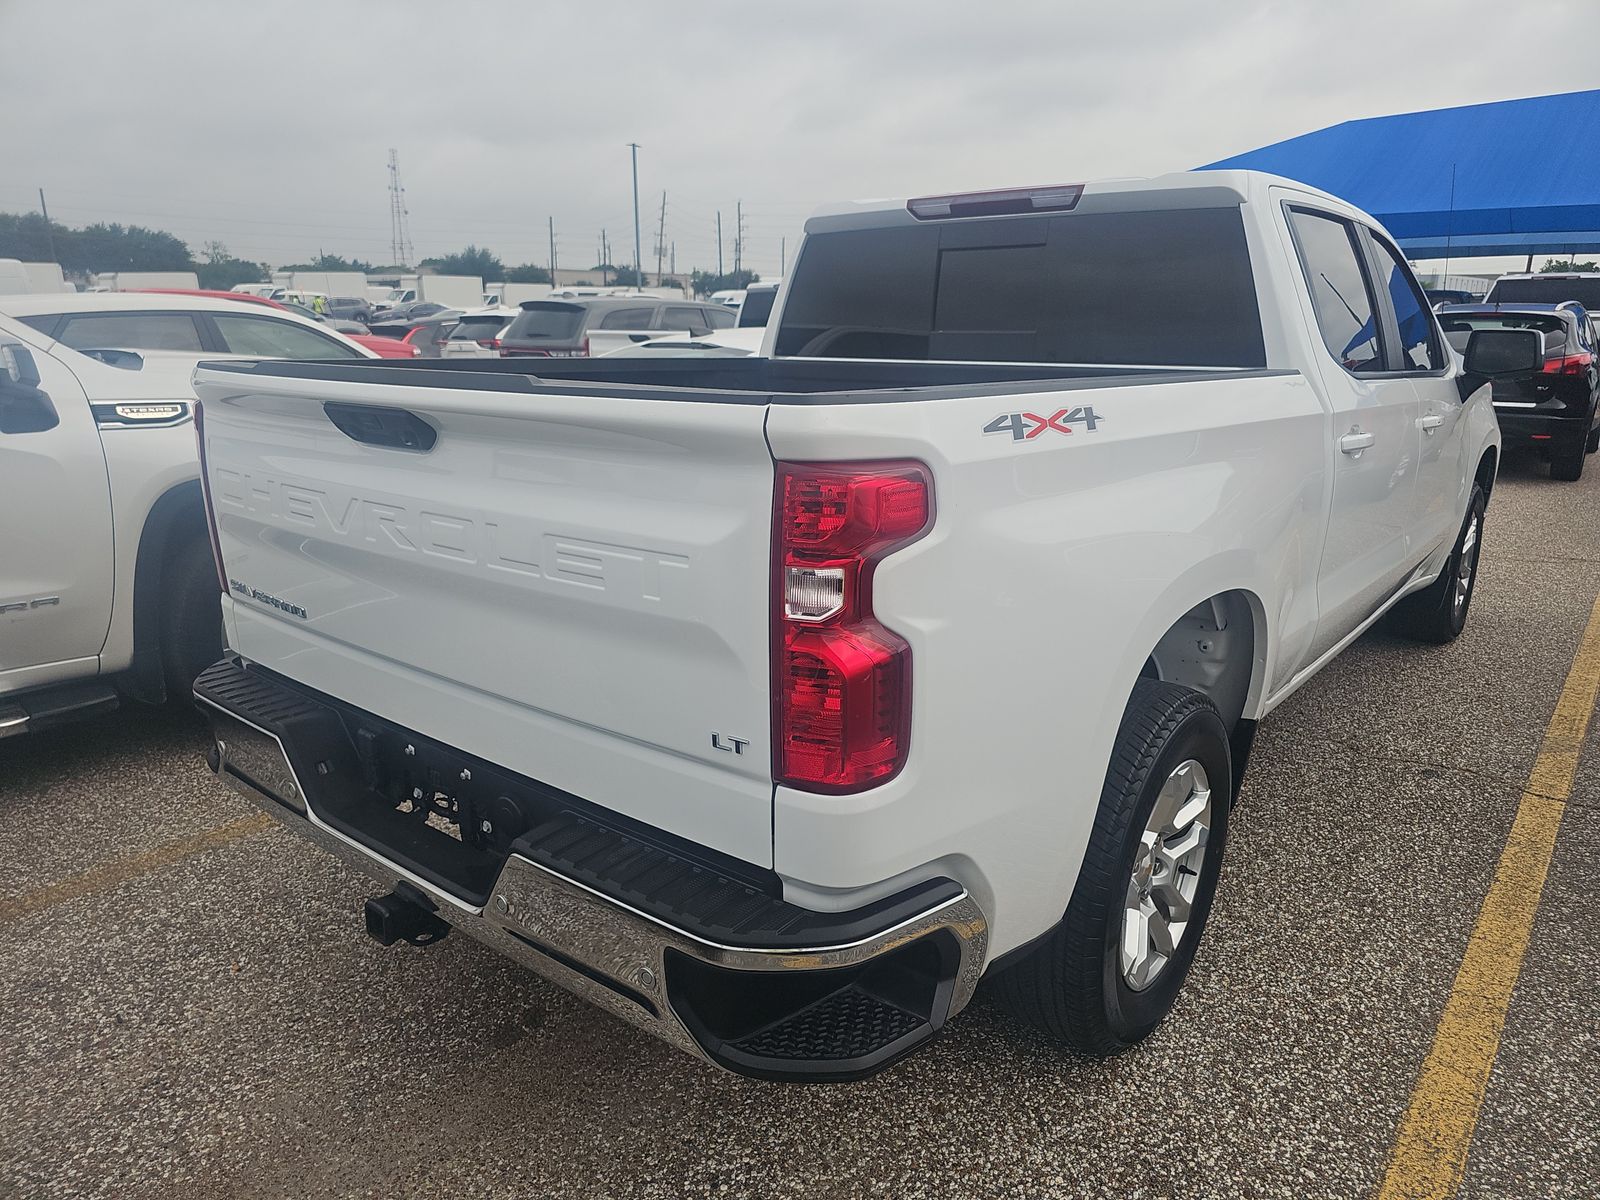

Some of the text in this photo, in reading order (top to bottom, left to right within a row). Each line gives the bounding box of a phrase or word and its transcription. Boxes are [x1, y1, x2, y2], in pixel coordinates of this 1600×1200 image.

[215, 468, 690, 601] CHEVROLET
[230, 579, 307, 619] SILVERADO
[711, 732, 750, 755] LT
